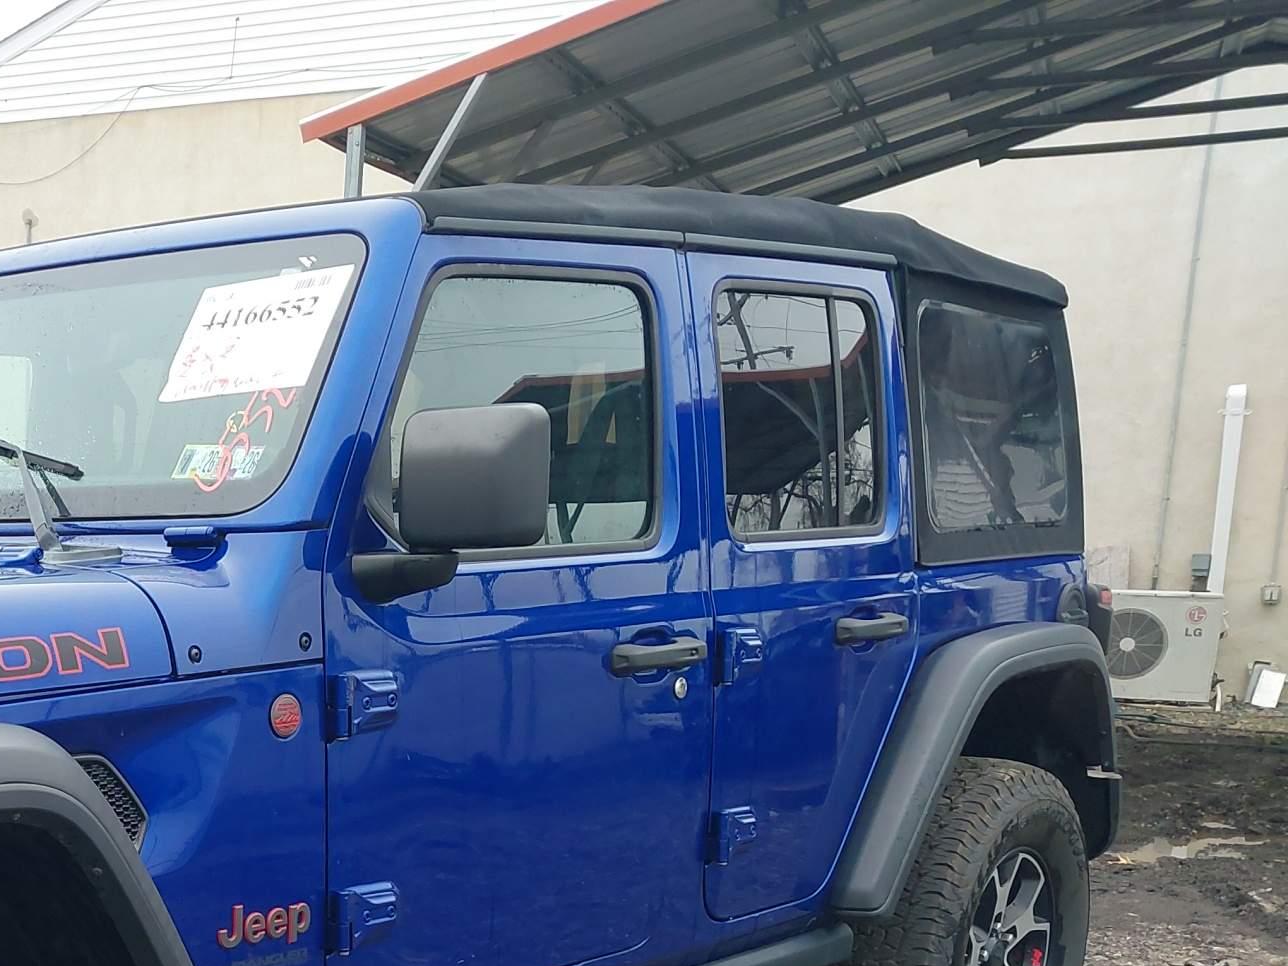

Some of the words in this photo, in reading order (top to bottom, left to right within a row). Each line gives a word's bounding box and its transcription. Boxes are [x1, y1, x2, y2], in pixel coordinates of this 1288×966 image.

[202, 296, 320, 331] 44166552
[1185, 627, 1202, 637] LG
[217, 902, 311, 948] Jeep
